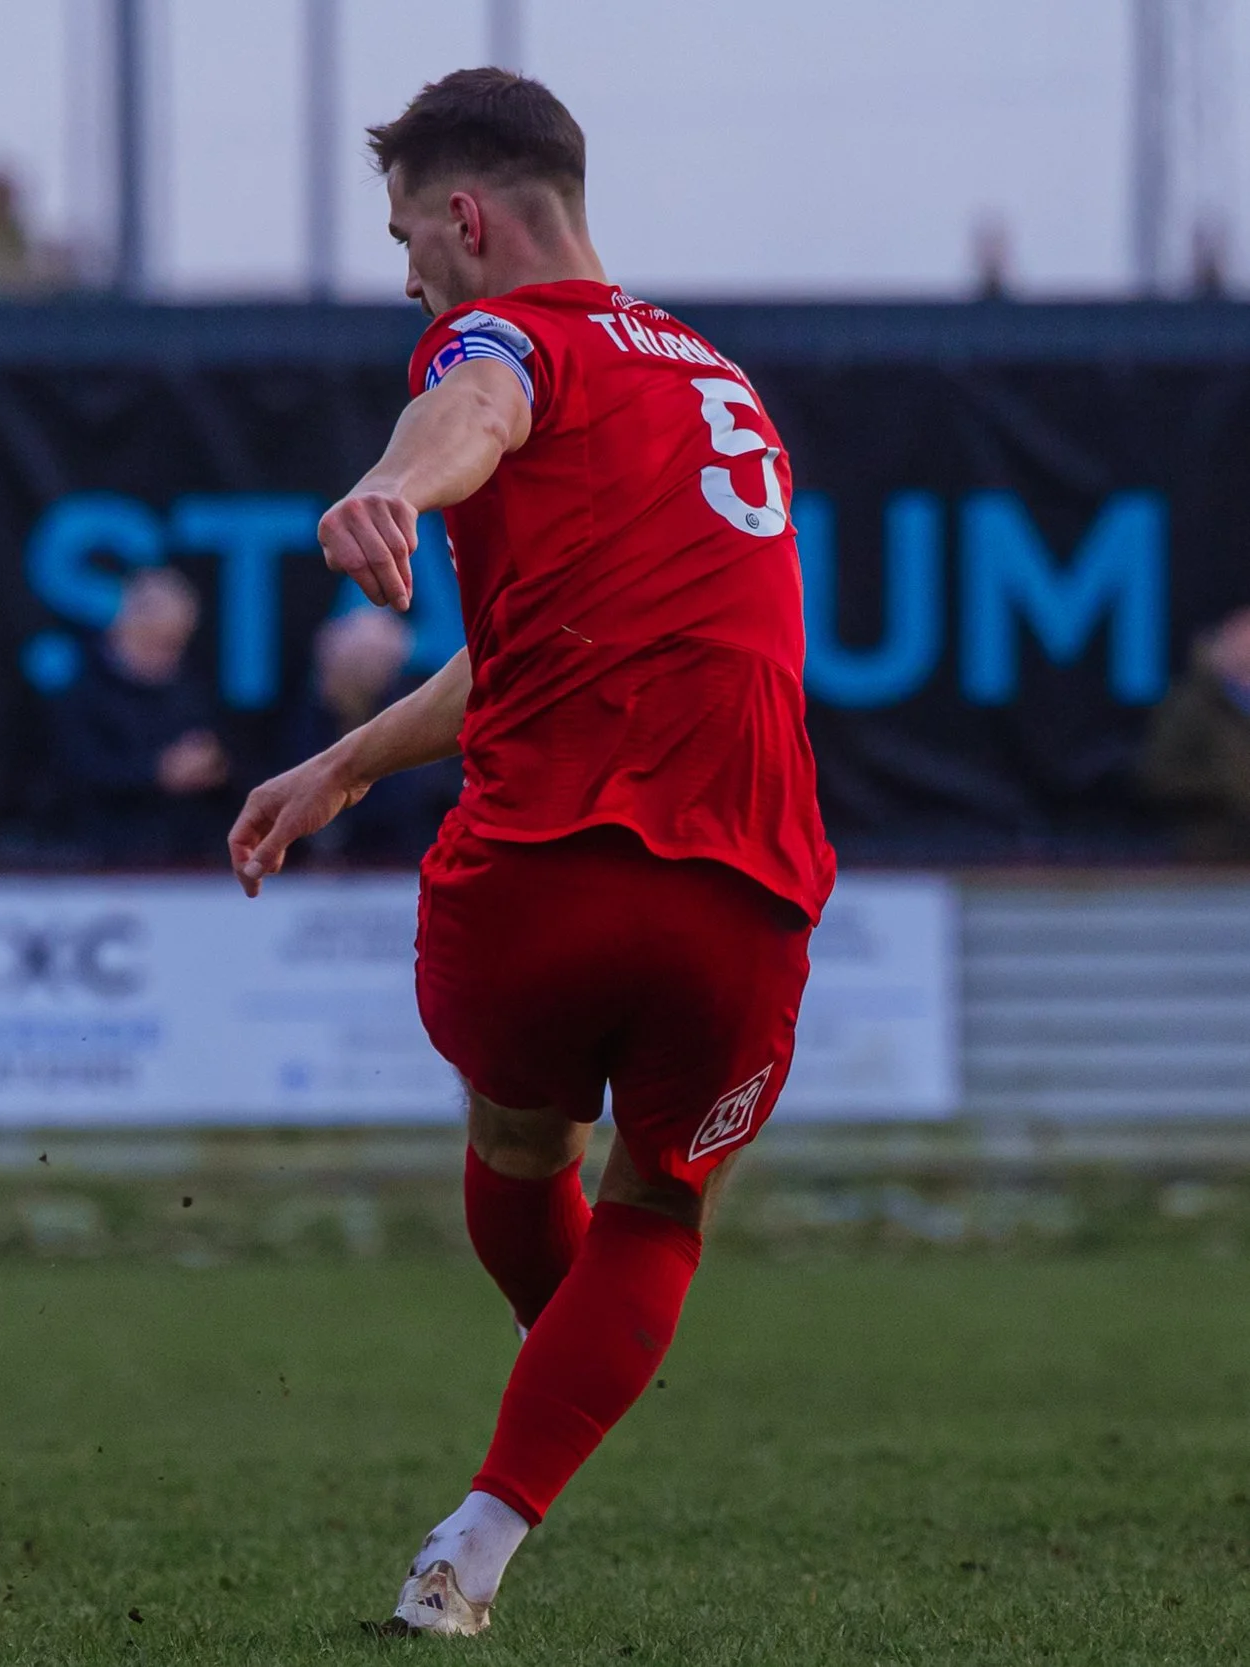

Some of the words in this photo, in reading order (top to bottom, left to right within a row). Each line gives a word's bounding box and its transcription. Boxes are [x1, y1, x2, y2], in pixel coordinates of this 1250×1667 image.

[432, 340, 464, 378] C
[690, 377, 787, 537] 5
[24, 488, 1172, 711] STUM
